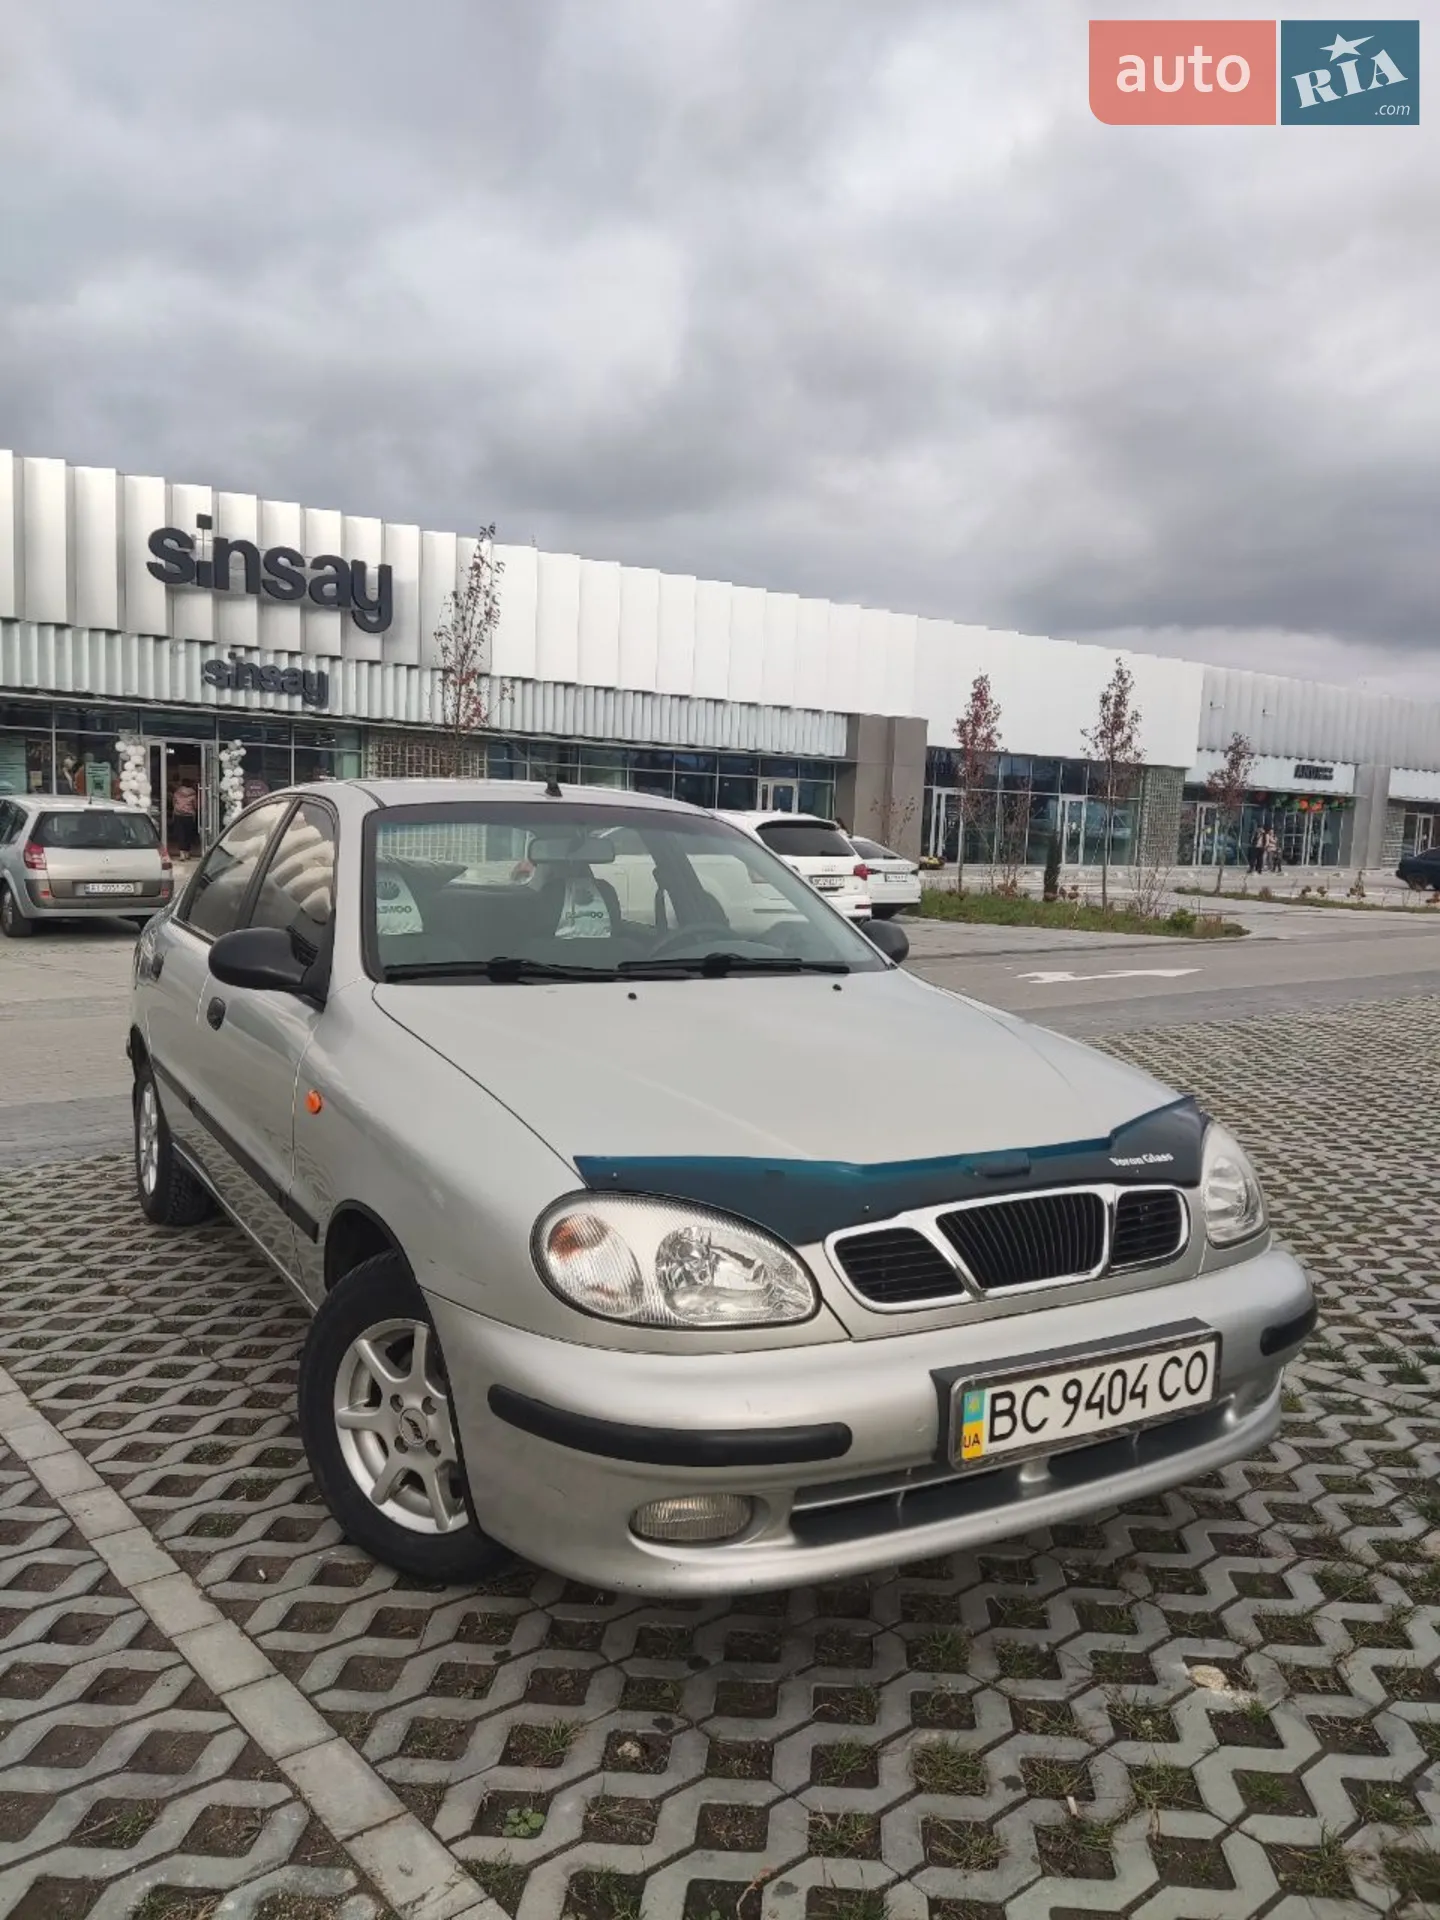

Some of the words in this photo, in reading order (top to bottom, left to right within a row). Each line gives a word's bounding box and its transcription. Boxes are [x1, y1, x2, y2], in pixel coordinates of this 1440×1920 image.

[147, 514, 392, 633] sinsay
[204, 651, 328, 707] sinsay
[988, 1384, 1050, 1443] BC
[1062, 1363, 1148, 1428] 9404
[1158, 1350, 1208, 1402] CO
[963, 1433, 981, 1448] UA
